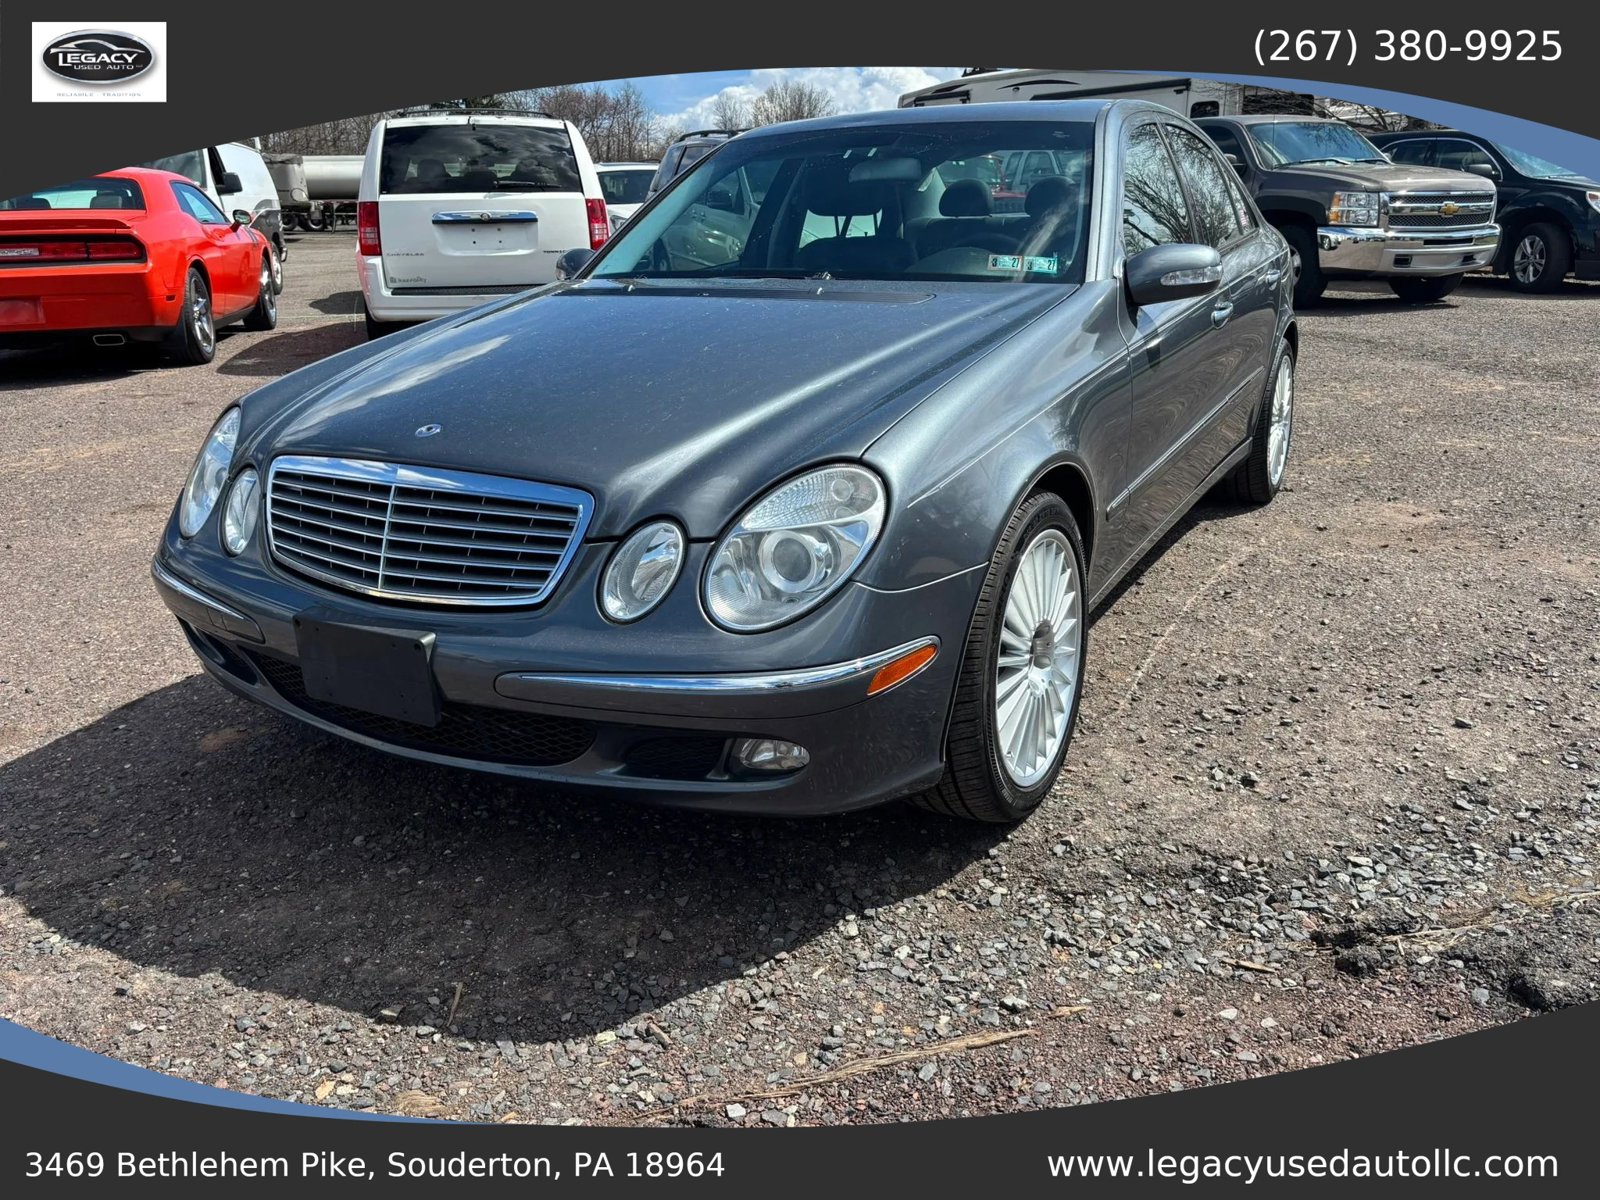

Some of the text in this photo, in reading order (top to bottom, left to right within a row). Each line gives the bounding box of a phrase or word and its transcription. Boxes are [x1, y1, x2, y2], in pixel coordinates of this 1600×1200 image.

[991, 258, 998, 268] 3
[1011, 257, 1020, 268] 27
[1047, 259, 1056, 270] 27
